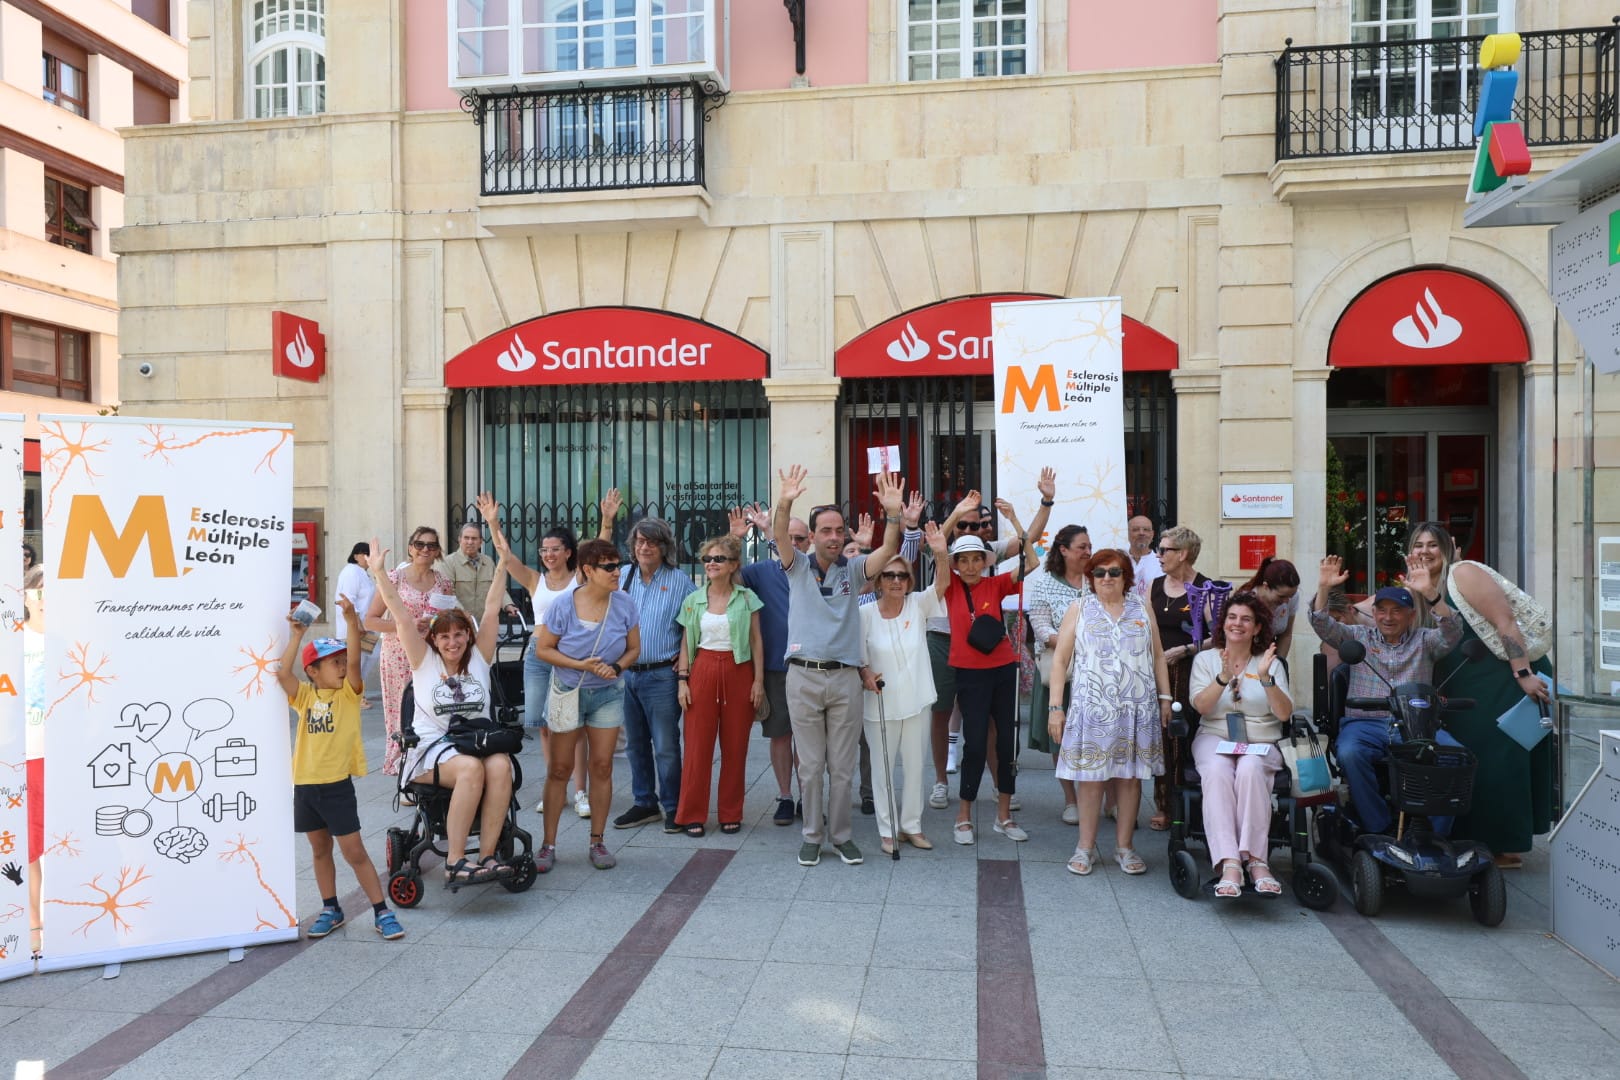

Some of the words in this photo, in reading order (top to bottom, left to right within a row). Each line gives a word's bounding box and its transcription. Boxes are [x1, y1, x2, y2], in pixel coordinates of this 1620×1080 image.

[542, 337, 712, 370] Santander
[1066, 369, 1119, 382] Esclerosis
[1066, 381, 1111, 394] Múltiple
[1065, 392, 1092, 403] León
[1020, 421, 1070, 431] Transformamos
[1072, 420, 1087, 428] retos
[1034, 436, 1060, 444] calidad
[1242, 494, 1283, 502] Santander
[191, 507, 285, 531] Esclerosis
[57, 494, 178, 579] M
[187, 526, 270, 550] Múltiple
[185, 546, 235, 565] León
[95, 599, 194, 616] Transformamos
[196, 597, 226, 611] retos
[229, 602, 244, 610] en
[125, 626, 174, 639] calidad
[176, 626, 192, 638] de
[194, 625, 221, 637] vida
[153, 760, 196, 794] M
